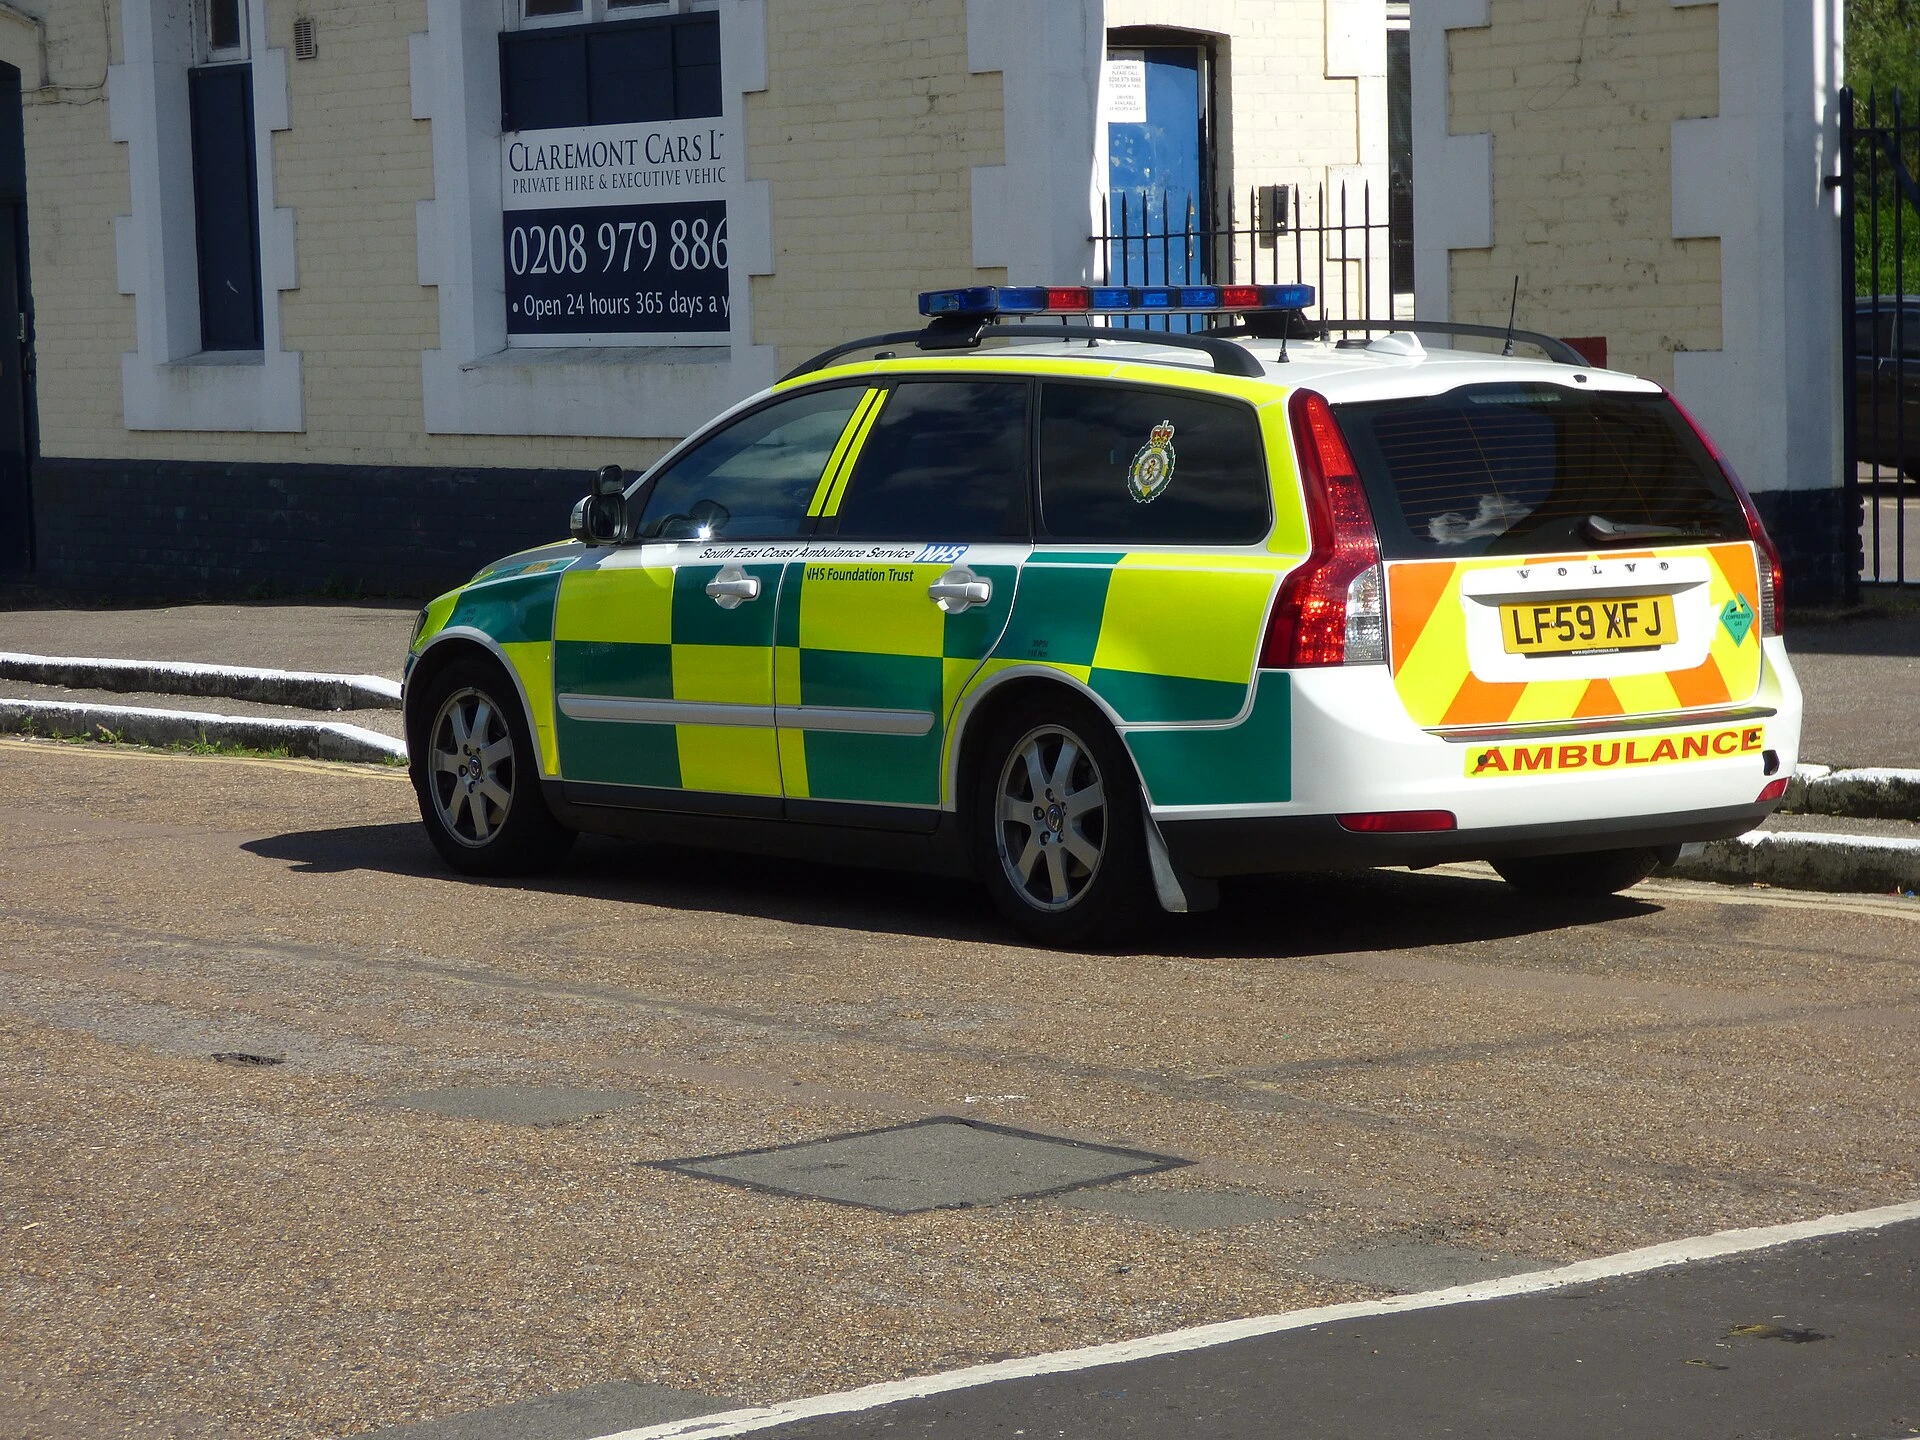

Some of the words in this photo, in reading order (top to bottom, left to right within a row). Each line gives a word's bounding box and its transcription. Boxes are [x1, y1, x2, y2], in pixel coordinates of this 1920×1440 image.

[509, 139, 638, 172] CLAREMONT
[645, 133, 702, 165] CARS
[709, 129, 725, 161] L
[512, 177, 560, 194] PRIVATE
[565, 174, 594, 191] HIRE
[599, 175, 608, 190] &
[612, 170, 681, 189] EXECUTIVE
[509, 223, 588, 276] 0208
[597, 220, 658, 273] 979
[669, 217, 729, 271] 886
[524, 294, 562, 321] Open
[566, 293, 585, 315] 24
[589, 292, 631, 314] hours
[635, 291, 663, 314] 365
[669, 290, 703, 318] days
[708, 296, 718, 313] a
[699, 547, 734, 559] South
[732, 547, 762, 559] East
[761, 547, 797, 559] Coast
[797, 547, 867, 559] Ambulance
[866, 547, 916, 559] Service
[916, 544, 968, 563] NHS
[827, 566, 886, 582] Foundation
[888, 568, 915, 582] Trust
[1516, 561, 1669, 579] VOLVO
[1512, 605, 1596, 645] LF59
[1602, 601, 1662, 639] XFJ
[1473, 727, 1764, 774] AMBULANCE
